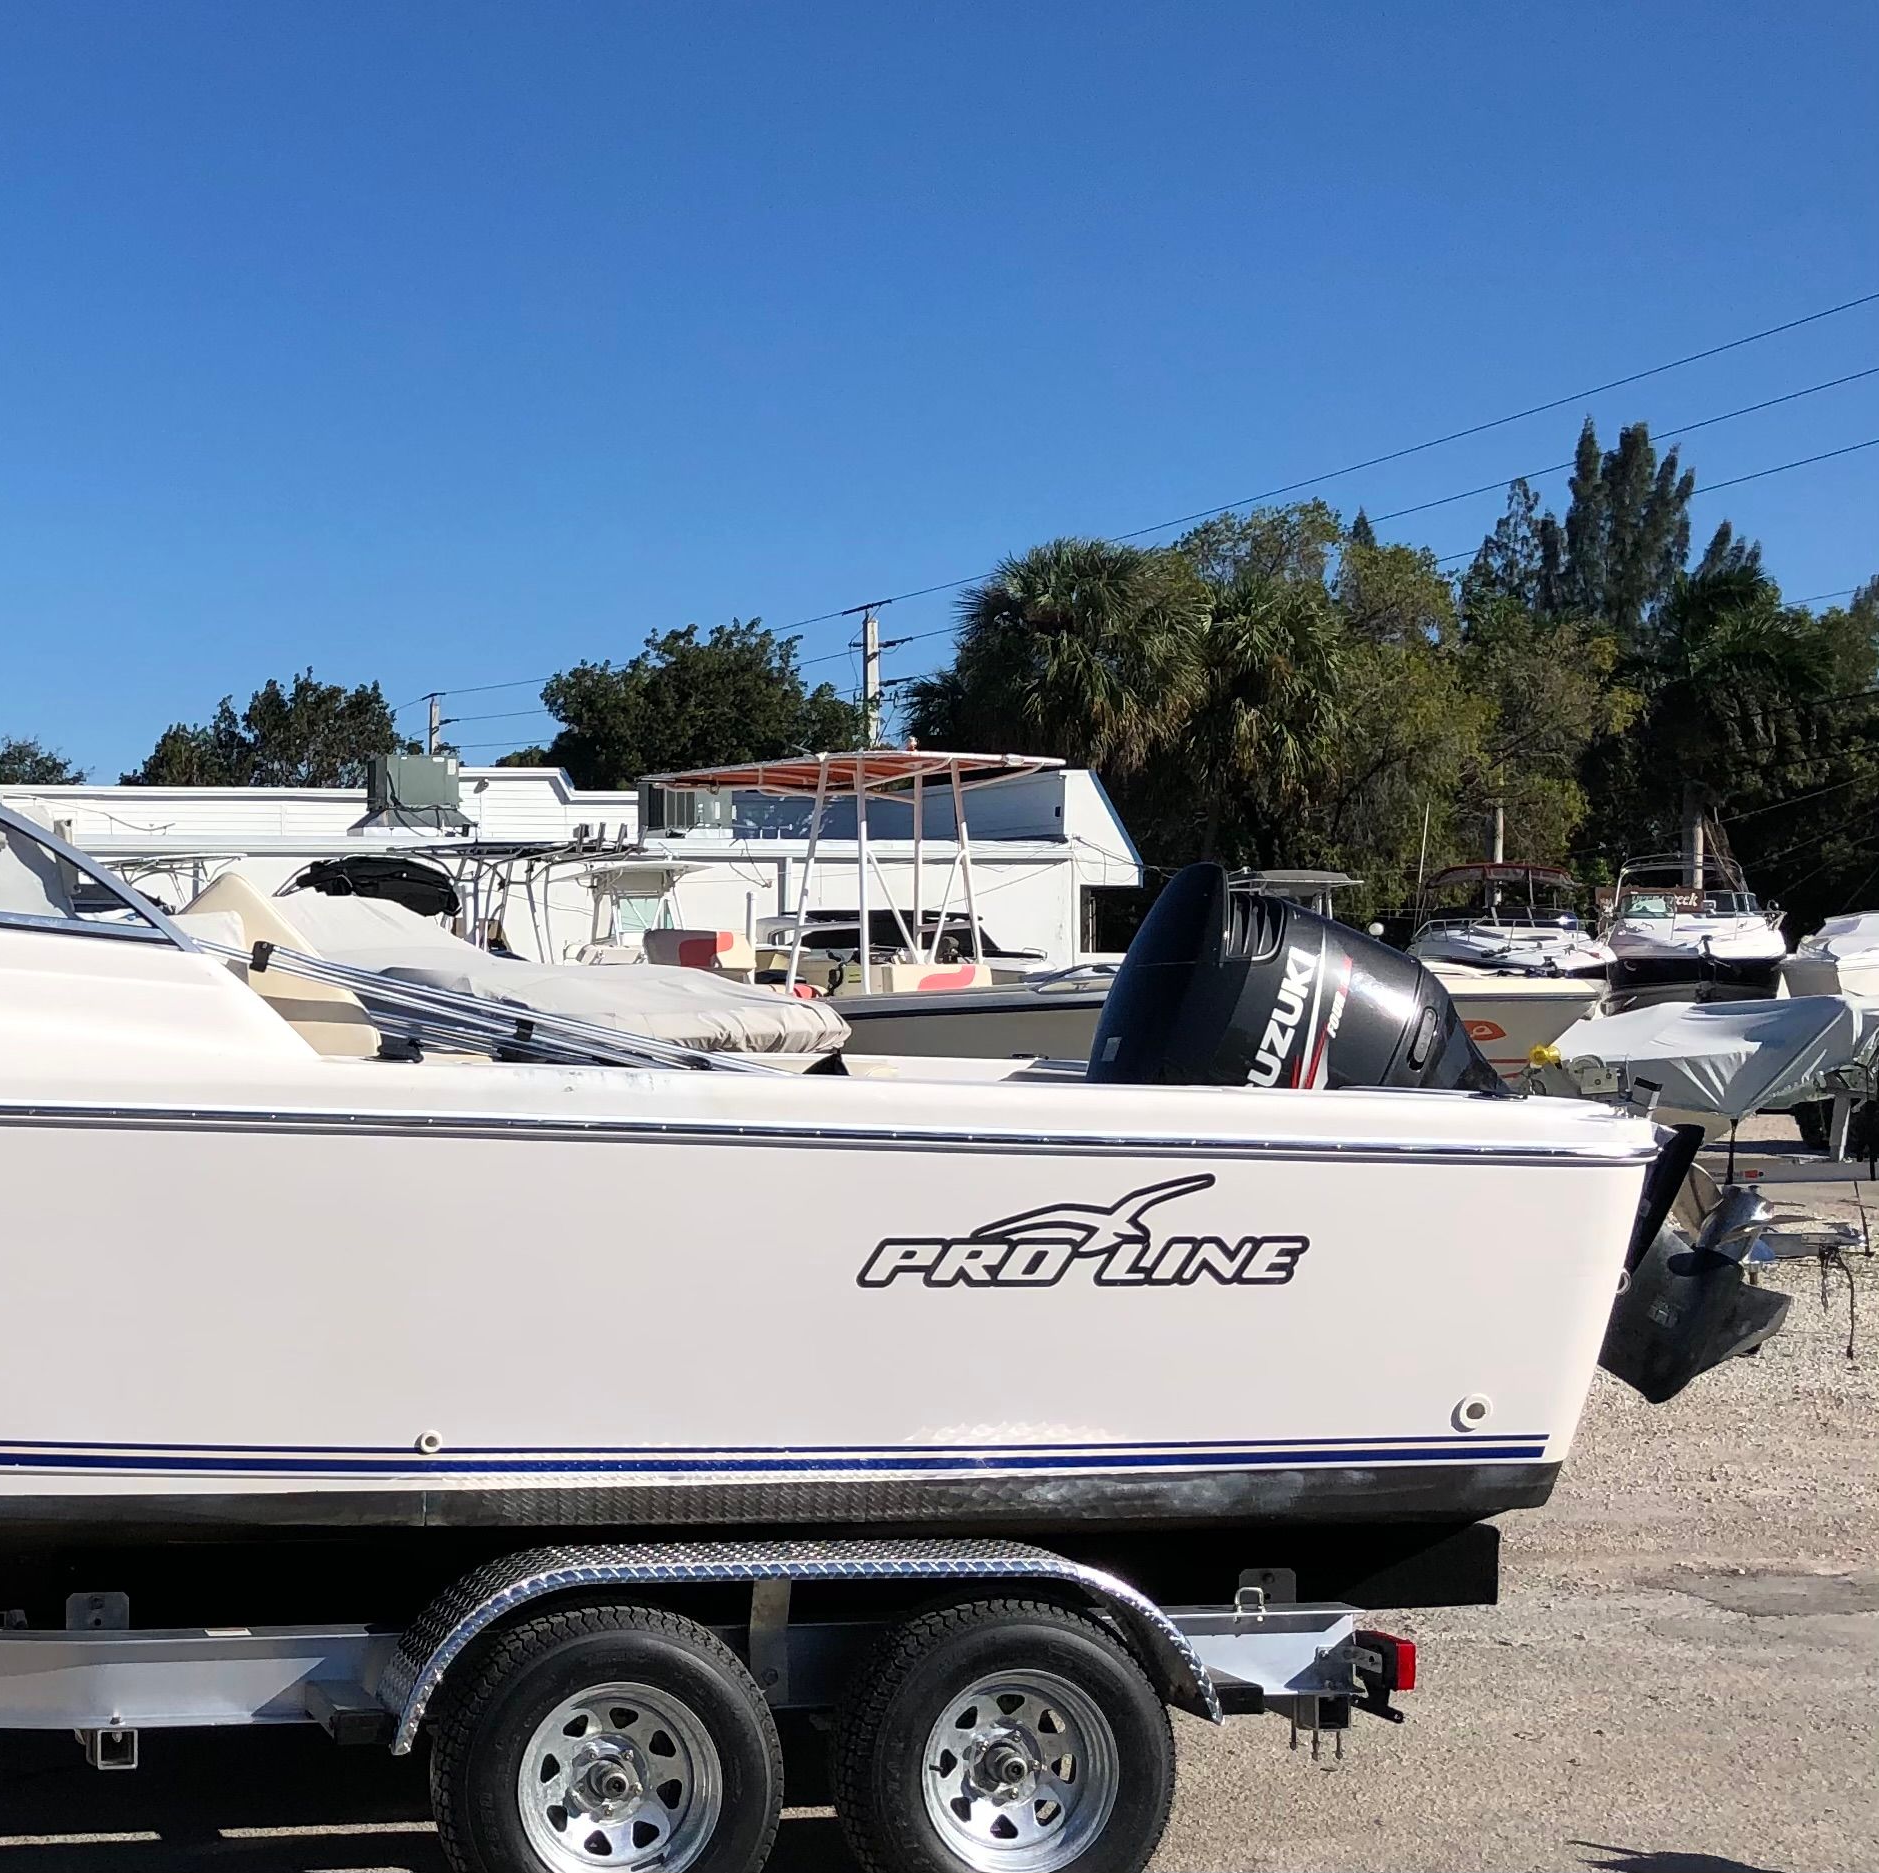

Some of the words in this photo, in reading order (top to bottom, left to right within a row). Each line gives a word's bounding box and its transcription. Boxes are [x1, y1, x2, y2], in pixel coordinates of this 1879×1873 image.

[1245, 946, 1321, 1088] UZUKI
[856, 1237, 1079, 1287] PRO
[1094, 1236, 1309, 1286] LINE
